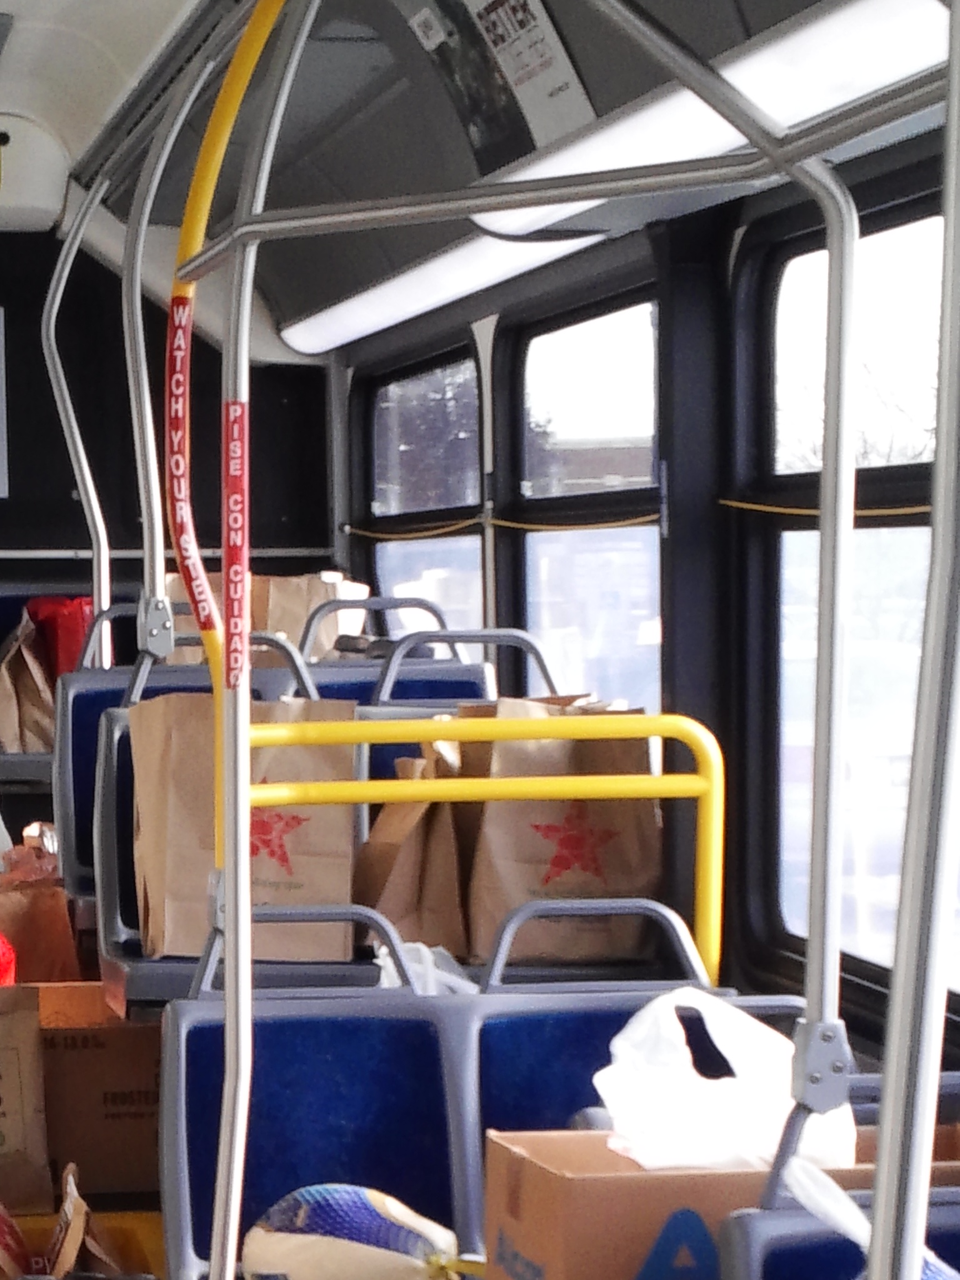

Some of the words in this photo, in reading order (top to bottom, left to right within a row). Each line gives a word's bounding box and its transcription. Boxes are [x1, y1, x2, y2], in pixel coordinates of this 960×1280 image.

[170, 305, 188, 418] WATCH
[170, 430, 189, 524] YOUR
[228, 404, 243, 477] PISE
[228, 494, 243, 546] CON
[179, 534, 210, 624] STEP
